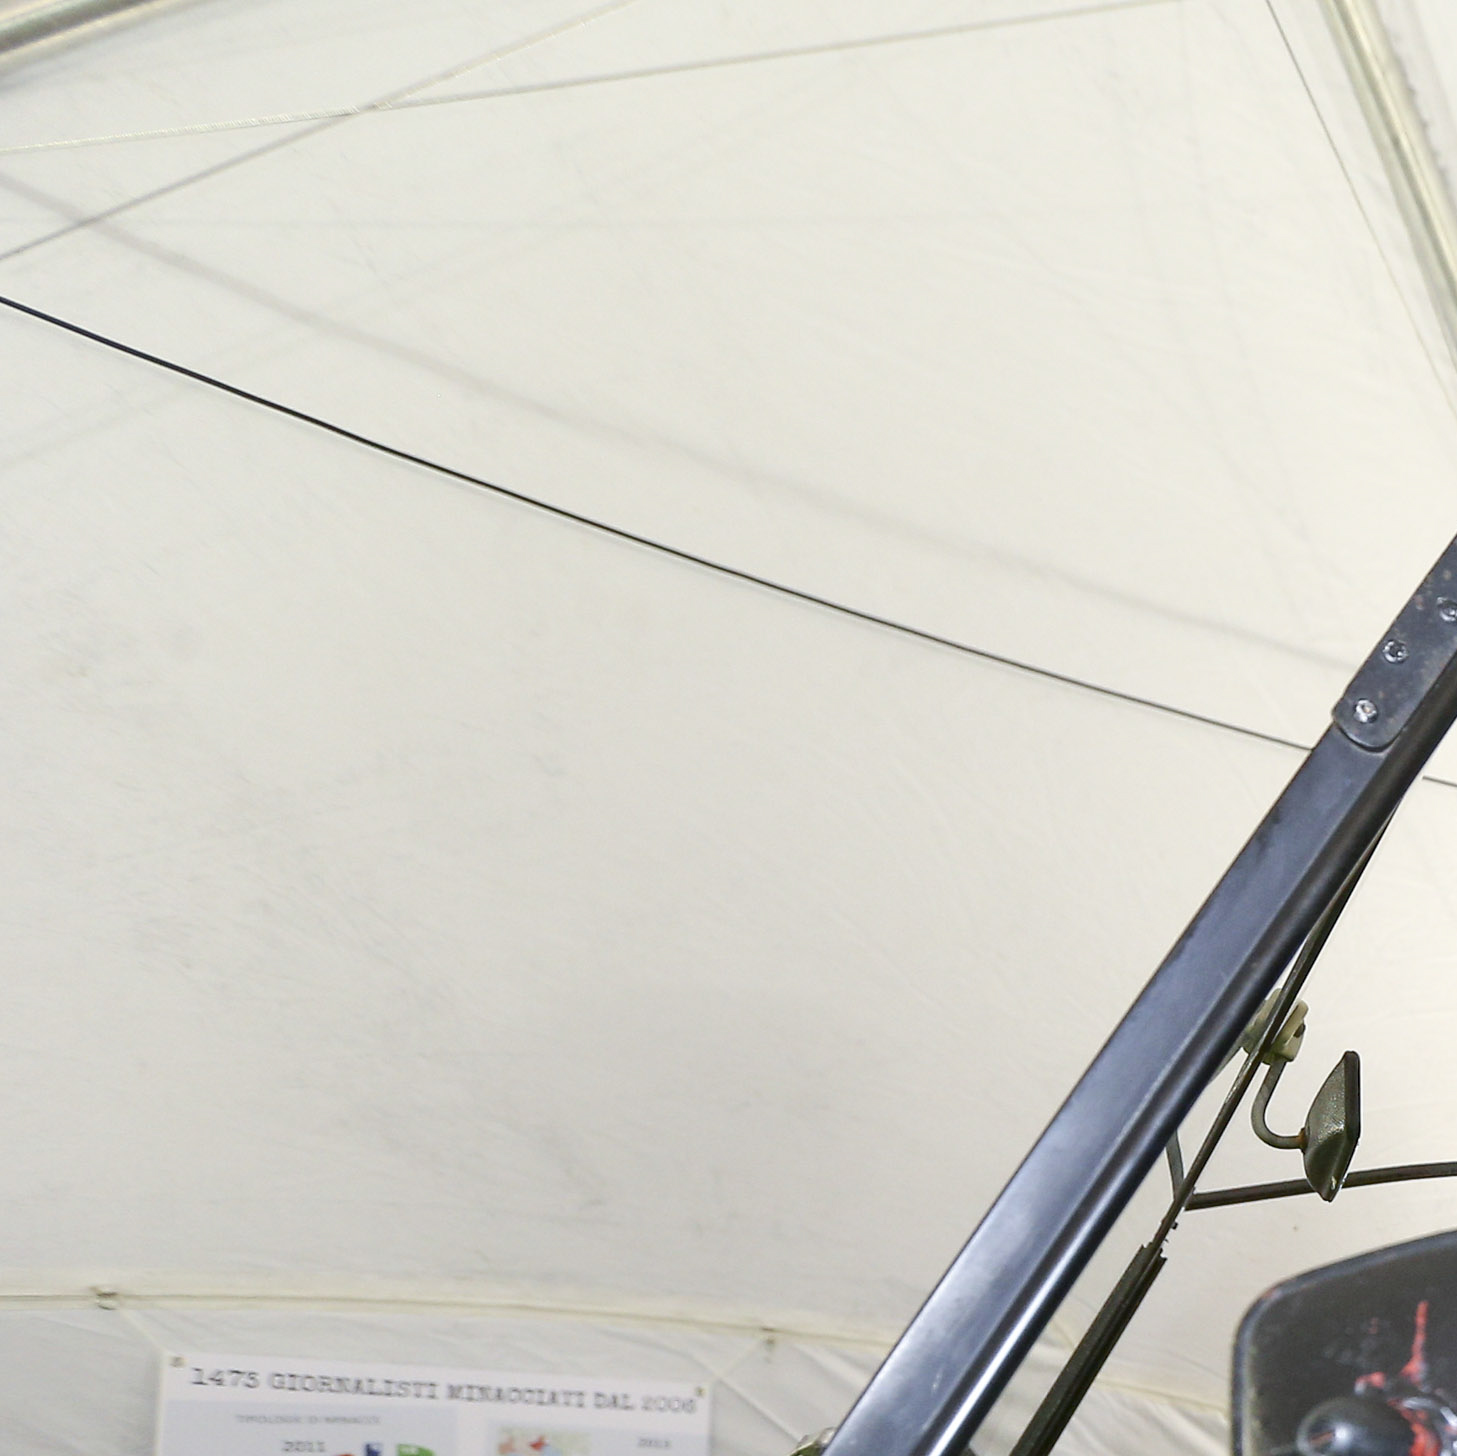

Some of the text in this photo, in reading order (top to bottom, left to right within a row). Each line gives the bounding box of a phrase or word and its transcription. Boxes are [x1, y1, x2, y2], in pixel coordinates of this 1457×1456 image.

[268, 1372, 440, 1400] GIORNALISTI
[447, 1383, 587, 1408] MINACCIATI
[593, 1391, 636, 1411] DAL
